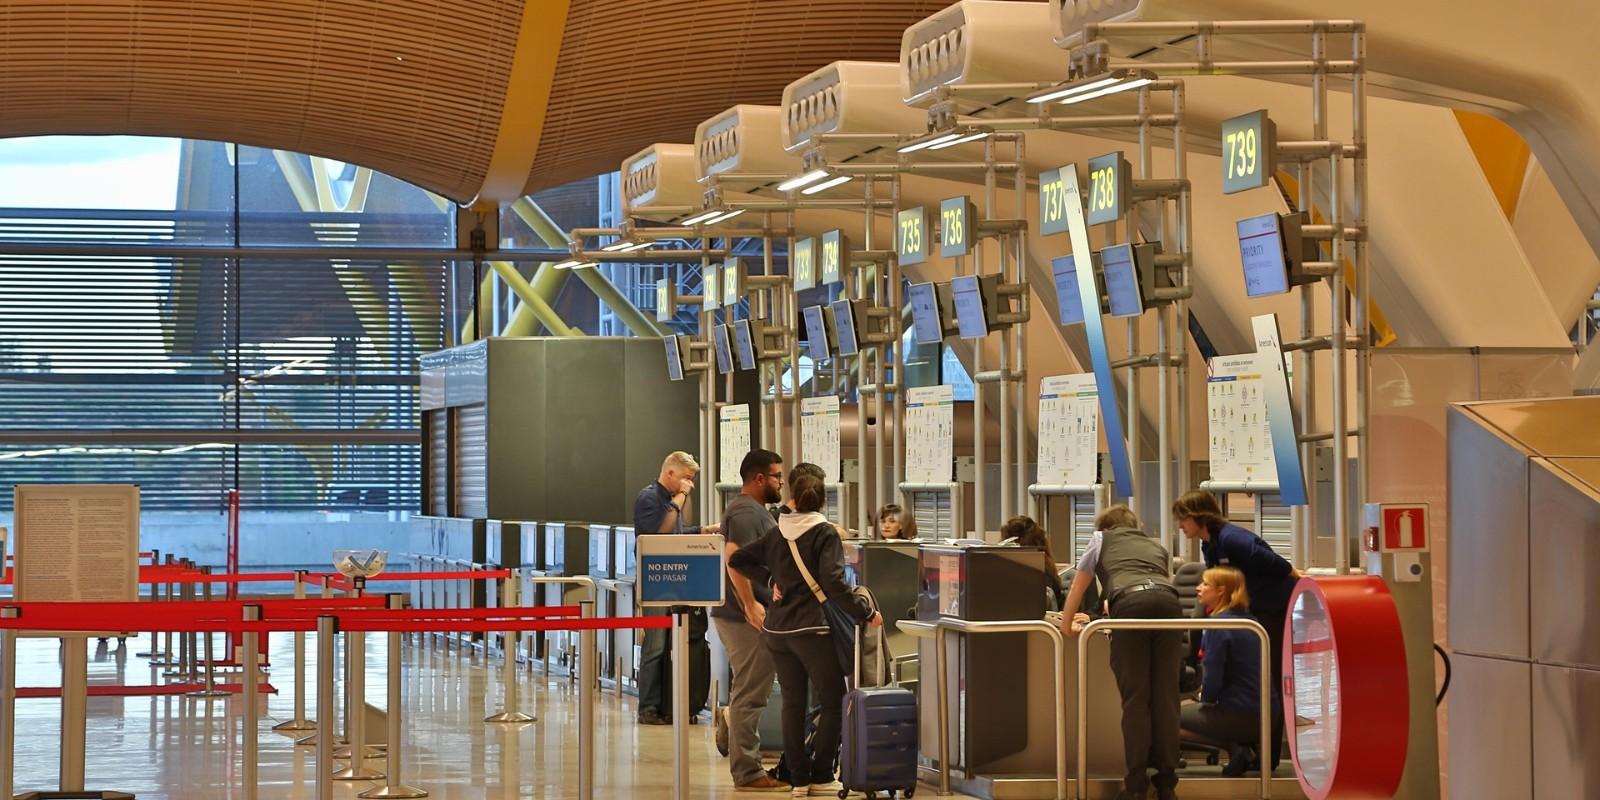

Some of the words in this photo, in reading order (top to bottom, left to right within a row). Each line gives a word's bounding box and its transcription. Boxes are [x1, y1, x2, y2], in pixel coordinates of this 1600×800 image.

[1226, 128, 1256, 179] 739
[1042, 180, 1063, 224] 737
[1091, 166, 1114, 212] 738
[901, 216, 919, 255] 735
[943, 209, 963, 246] 736
[796, 247, 811, 281] 733
[824, 240, 838, 274] 734
[1242, 245, 1264, 258] PRIORITY
